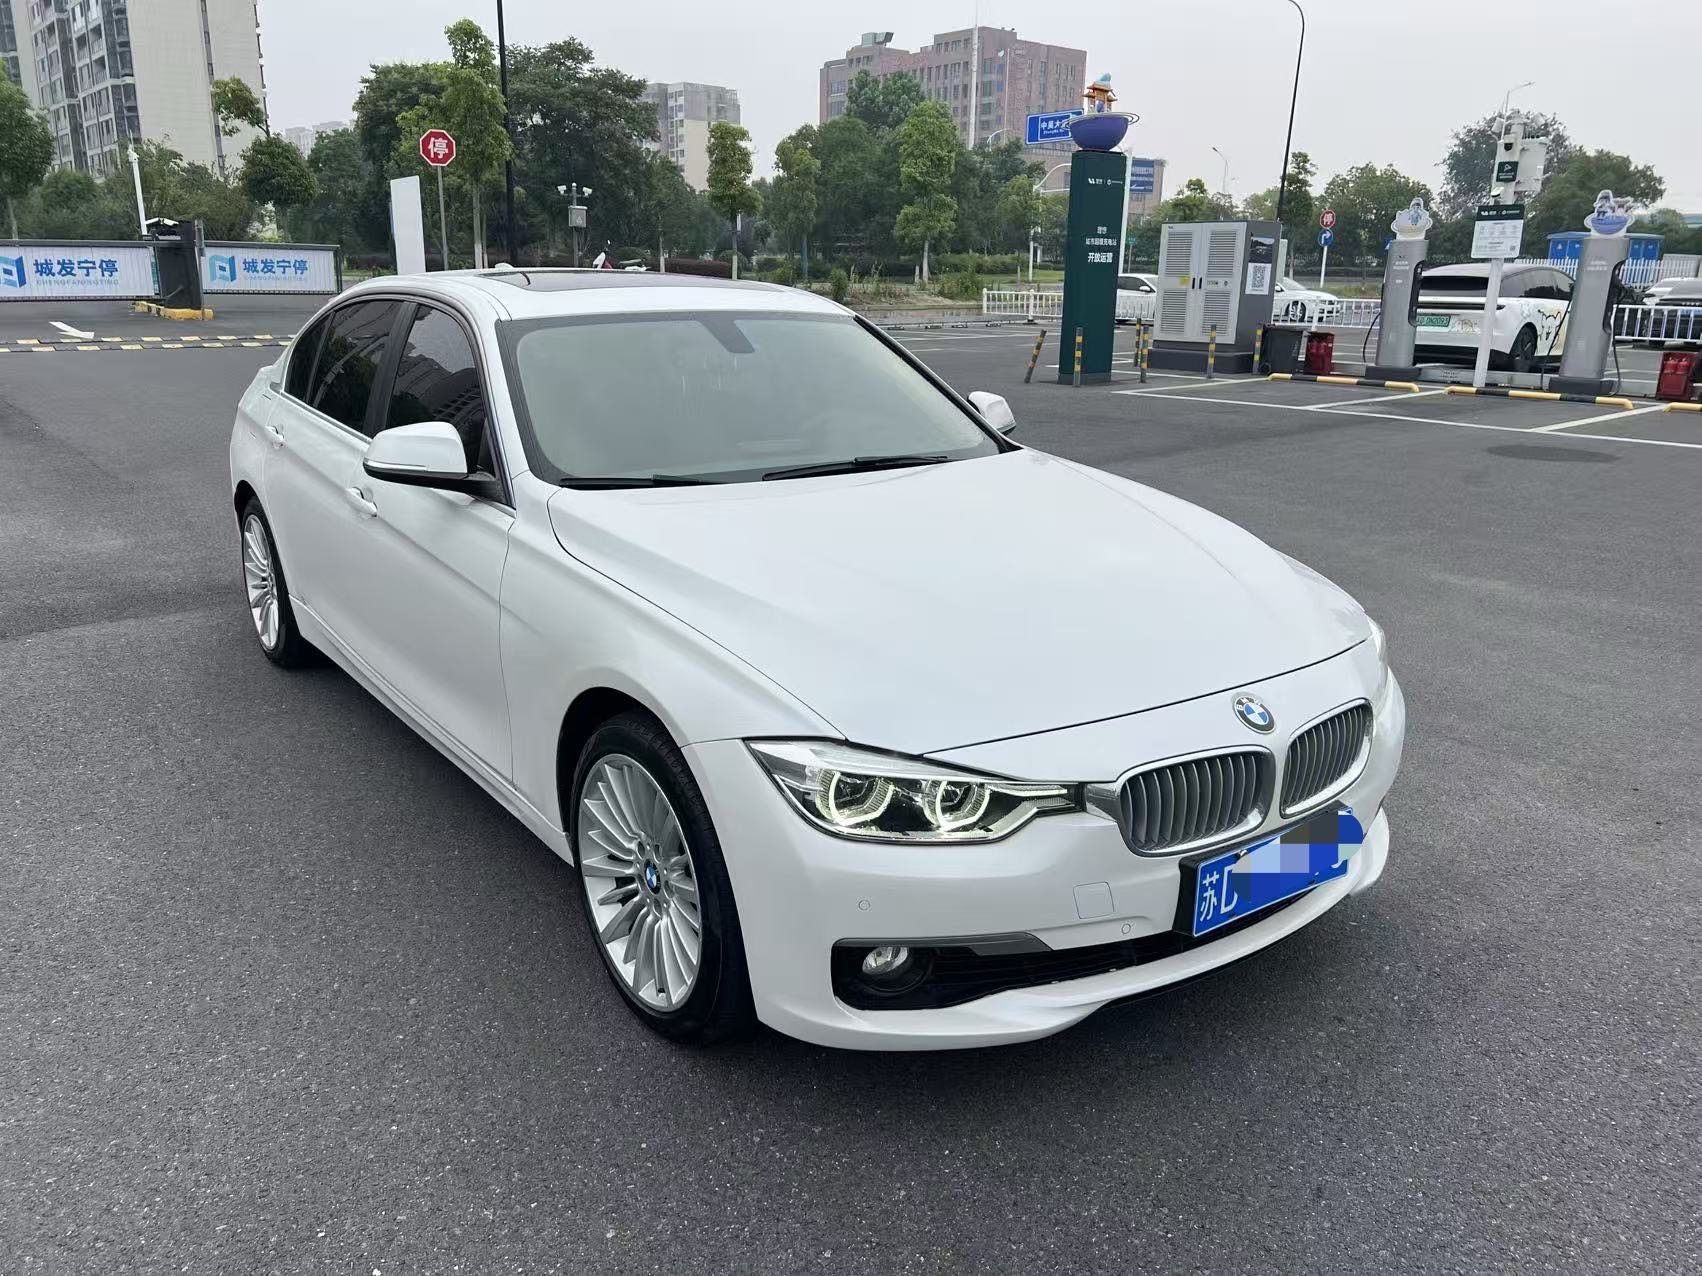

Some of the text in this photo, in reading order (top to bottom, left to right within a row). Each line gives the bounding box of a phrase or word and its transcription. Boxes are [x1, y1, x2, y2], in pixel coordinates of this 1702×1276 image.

[428, 137, 449, 158] 停
[243, 258, 308, 274] 城发宁停
[1088, 253, 1113, 263] 开放运营
[33, 258, 118, 277] 城发宁停
